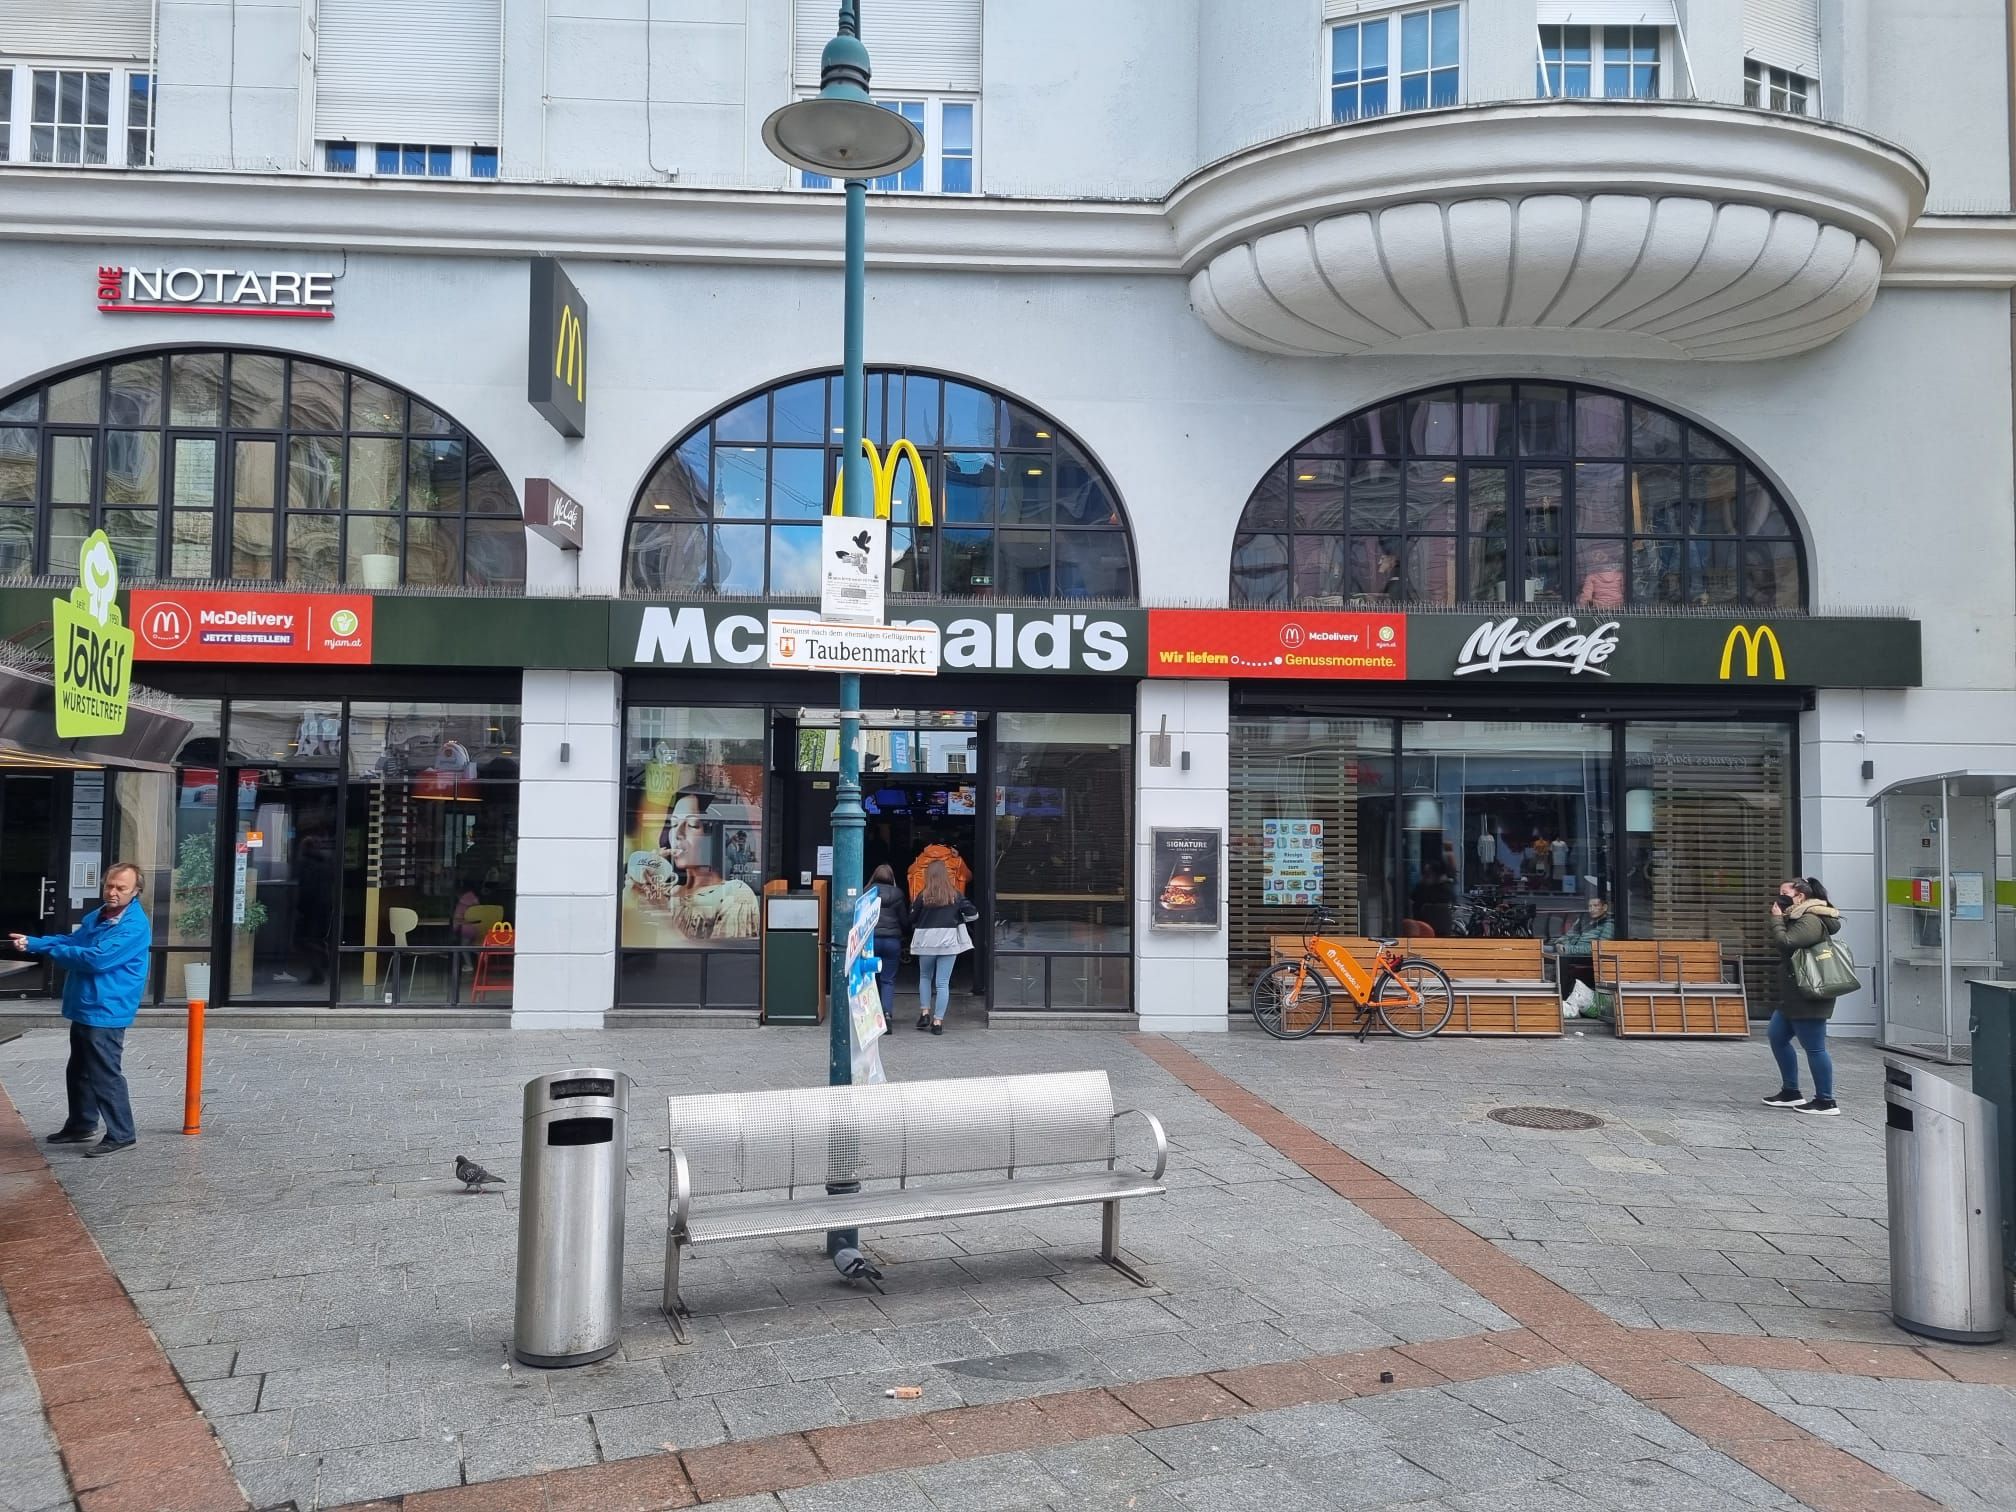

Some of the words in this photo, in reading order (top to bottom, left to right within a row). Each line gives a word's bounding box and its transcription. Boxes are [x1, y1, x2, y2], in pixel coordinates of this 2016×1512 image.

[97, 266, 123, 300] DIE
[128, 267, 334, 306] NOTARE
[552, 496, 578, 531] McCafé
[200, 610, 294, 629] McDelivery
[203, 633, 233, 642] JETZT
[234, 634, 290, 644] BESTELLEN!
[324, 637, 362, 650] mjam.at
[633, 606, 1130, 672] Mcald's
[782, 627, 810, 636] Benannt
[811, 628, 828, 637] nach
[829, 629, 843, 637] dem
[844, 630, 881, 640] ehemaligen
[1309, 631, 1359, 643] McDelivery
[805, 638, 926, 665] Taubenmarkt
[1456, 617, 1620, 675] McCafé
[1159, 651, 1184, 663] Wir
[1186, 651, 1229, 664] liefern
[1285, 653, 1397, 668] Genussmomente.
[62, 687, 123, 722] WÜRSTELTREFF
[1166, 841, 1208, 849] SIGNATURE
